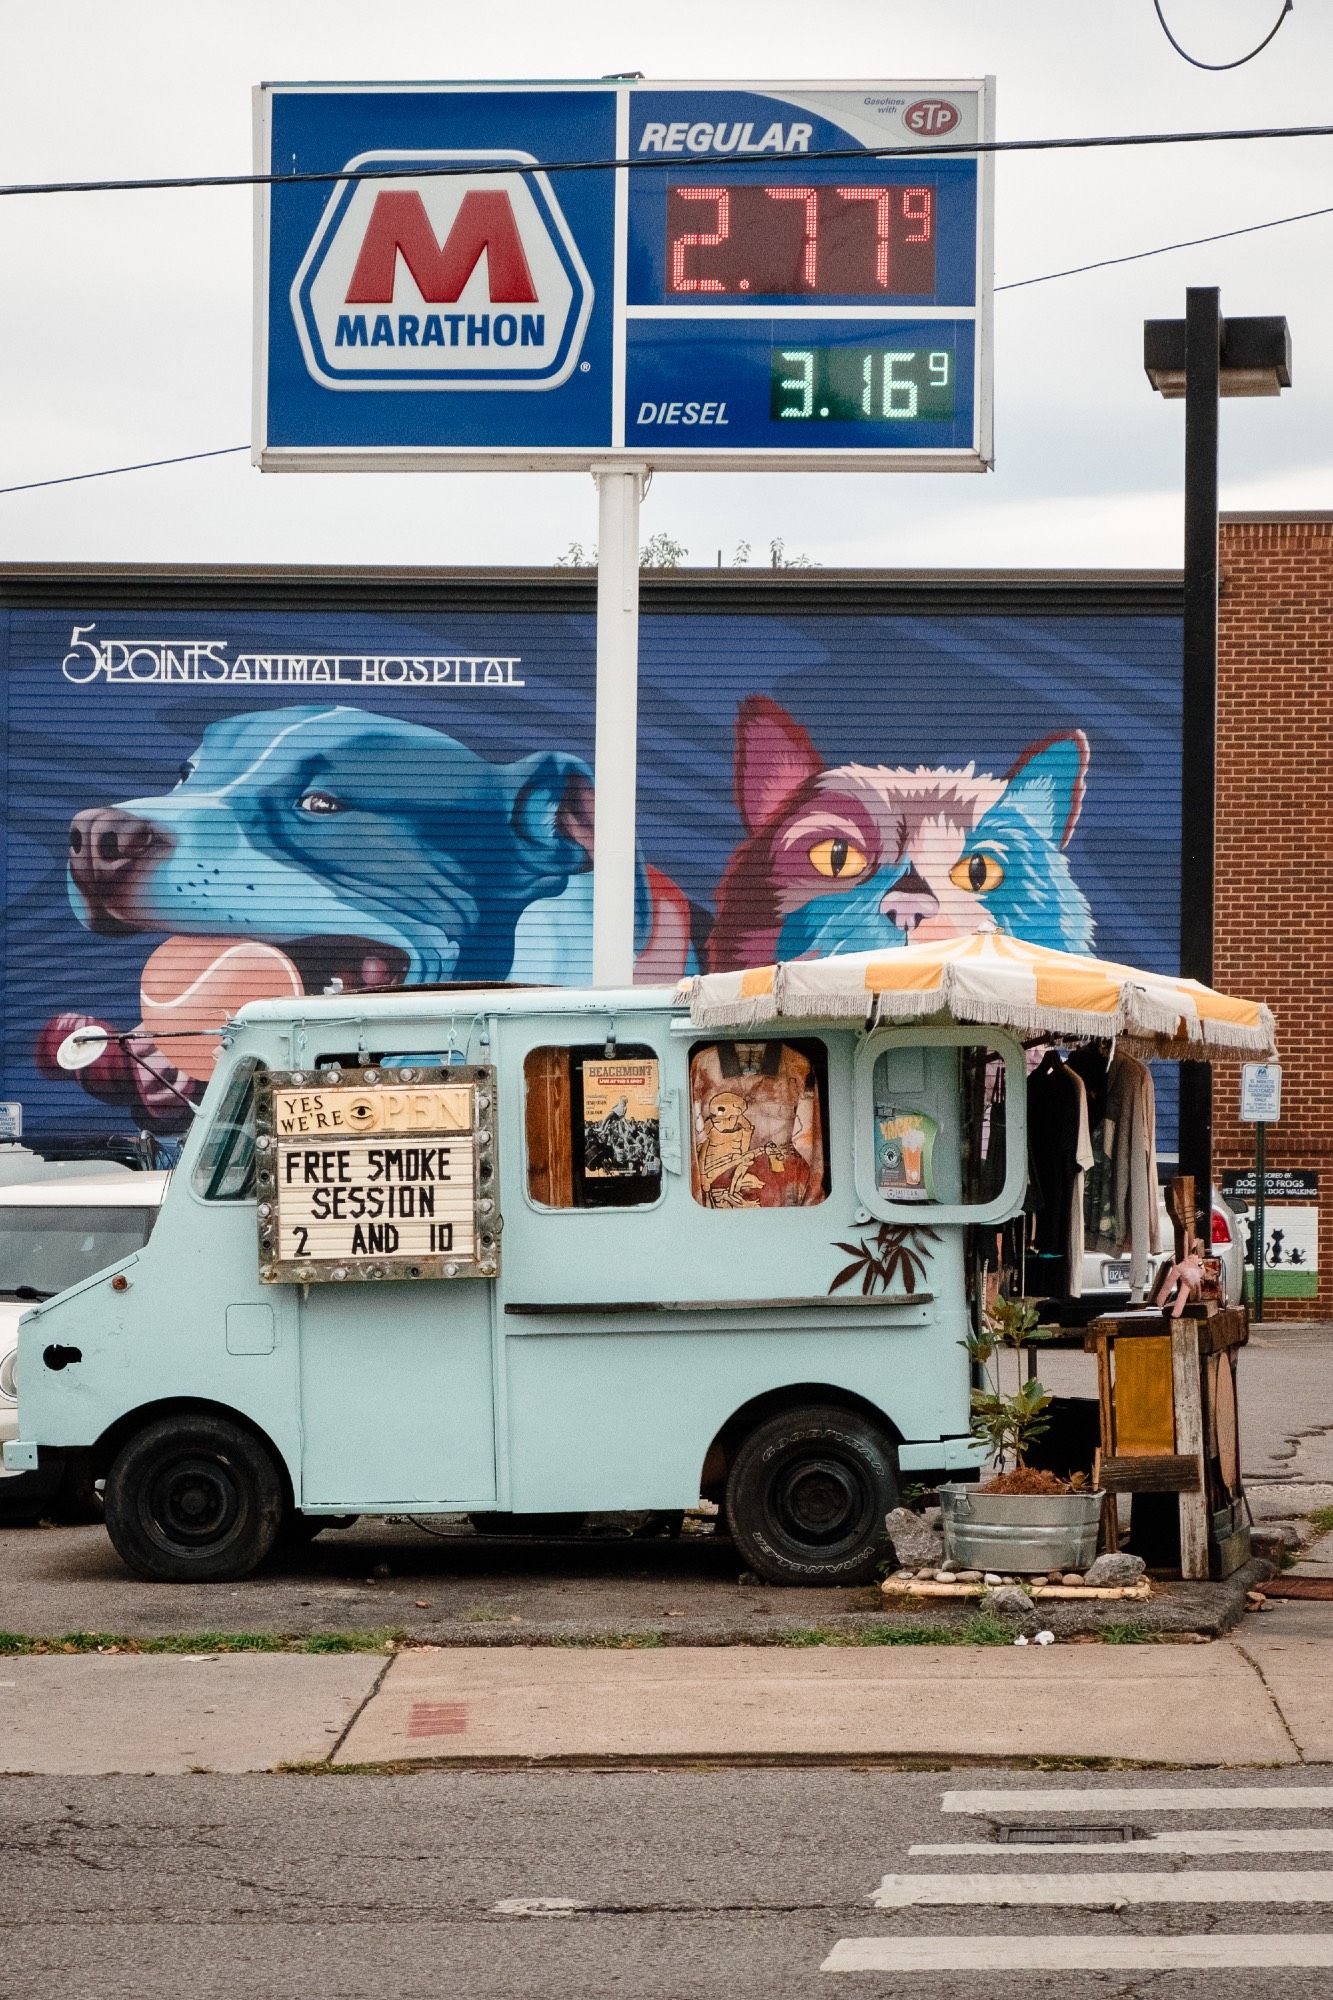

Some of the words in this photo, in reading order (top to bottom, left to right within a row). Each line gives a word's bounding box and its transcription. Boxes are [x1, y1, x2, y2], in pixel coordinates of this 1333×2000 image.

[864, 97, 905, 106] Gasolines
[911, 104, 952, 129] STP
[638, 122, 813, 152] REGULAR
[334, 314, 545, 347] MARATHON
[636, 402, 729, 425] DIESEL
[231, 654, 351, 686] ANIMAL
[361, 656, 525, 687] HOSPITAL
[589, 1066, 653, 1077] BEACHMONT
[284, 1095, 325, 1114] YES
[281, 1110, 344, 1132] WE'RE
[286, 1151, 351, 1184] FREE
[367, 1148, 451, 1182] SMOKE
[1276, 1180, 1304, 1188] FROGS
[311, 1185, 435, 1219] SESSION
[293, 1226, 311, 1258] 2
[351, 1223, 399, 1255] AND
[430, 1223, 453, 1252] 10
